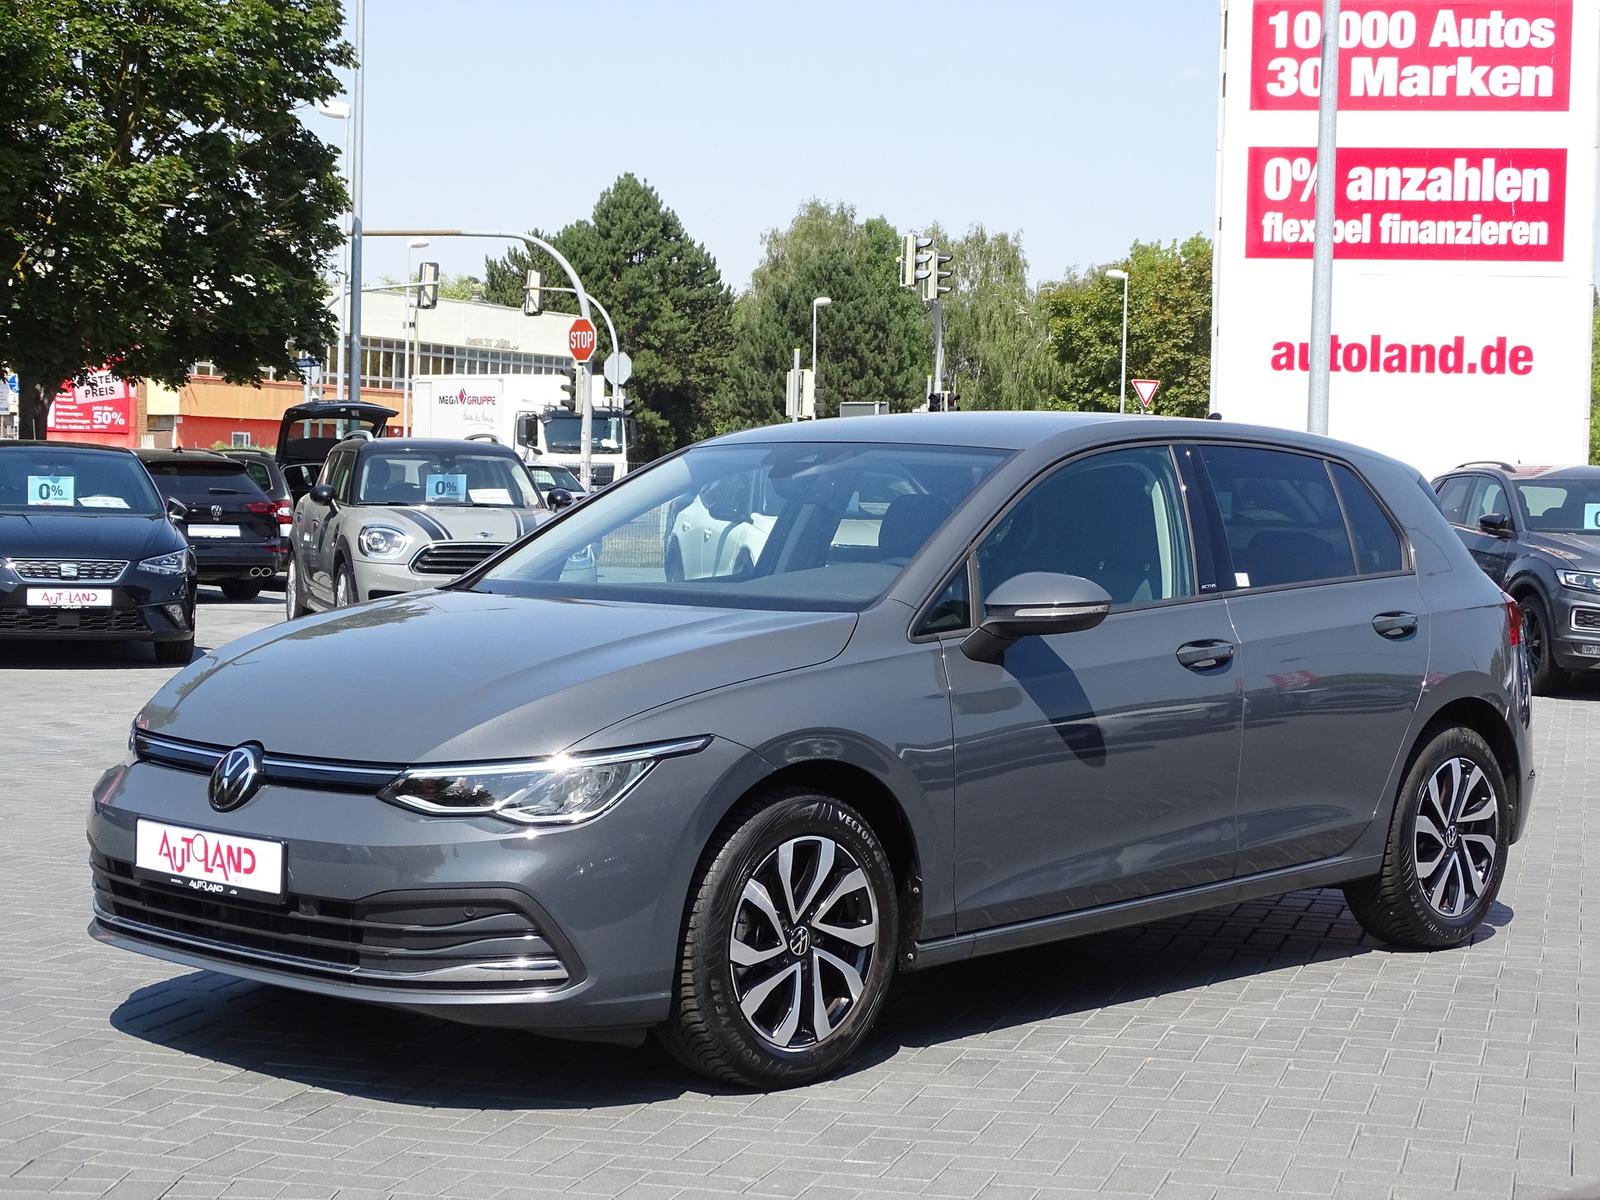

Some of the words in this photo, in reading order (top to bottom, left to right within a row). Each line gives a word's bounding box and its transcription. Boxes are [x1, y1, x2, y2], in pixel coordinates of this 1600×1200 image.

[1428, 9, 1556, 49] Autos
[1266, 57, 1322, 97] 30
[1350, 56, 1554, 98] Marken
[1346, 157, 1550, 203] anzahlen
[1261, 211, 1371, 245] flexbel
[1379, 213, 1549, 246] finanzieren
[570, 331, 593, 349] STOP
[84, 386, 115, 398] PREIS
[93, 411, 125, 426] 50%
[38, 483, 64, 500] 0%
[434, 481, 457, 495] 0%
[837, 810, 876, 849] VECTOR
[158, 829, 257, 882] AUTOLAND
